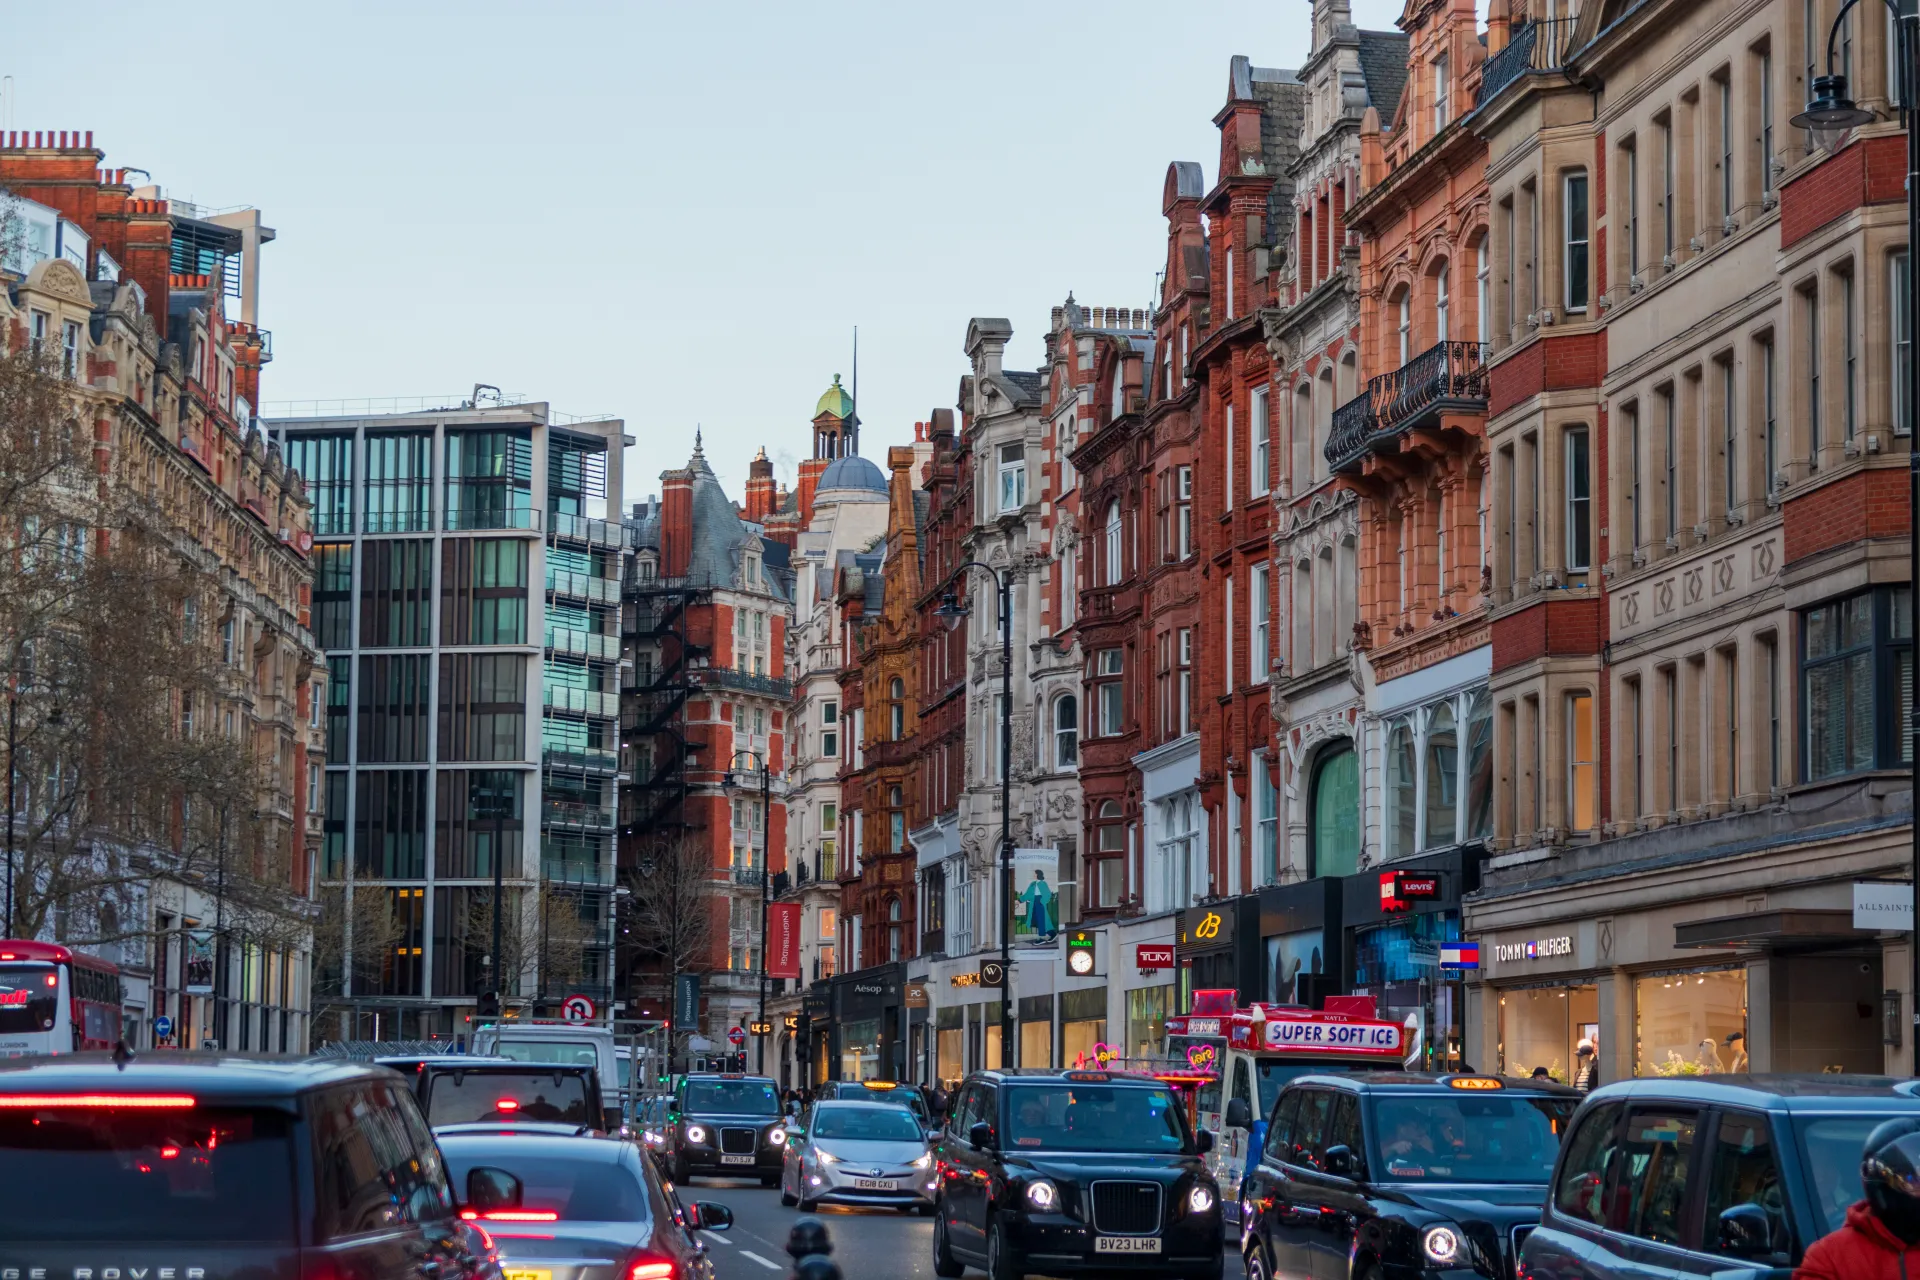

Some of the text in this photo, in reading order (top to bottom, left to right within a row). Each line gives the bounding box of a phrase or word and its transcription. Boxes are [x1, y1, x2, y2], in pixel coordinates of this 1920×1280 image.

[1858, 904, 1914, 912] ALLSAINTS
[1495, 937, 1571, 961] TOMMY HILFIGER
[1140, 951, 1171, 961] TUMI
[1273, 1025, 1393, 1044] SUPER SOFT ICE
[1101, 1238, 1157, 1250] BV23 LHR
[75, 1268, 205, 1279] ROVER
